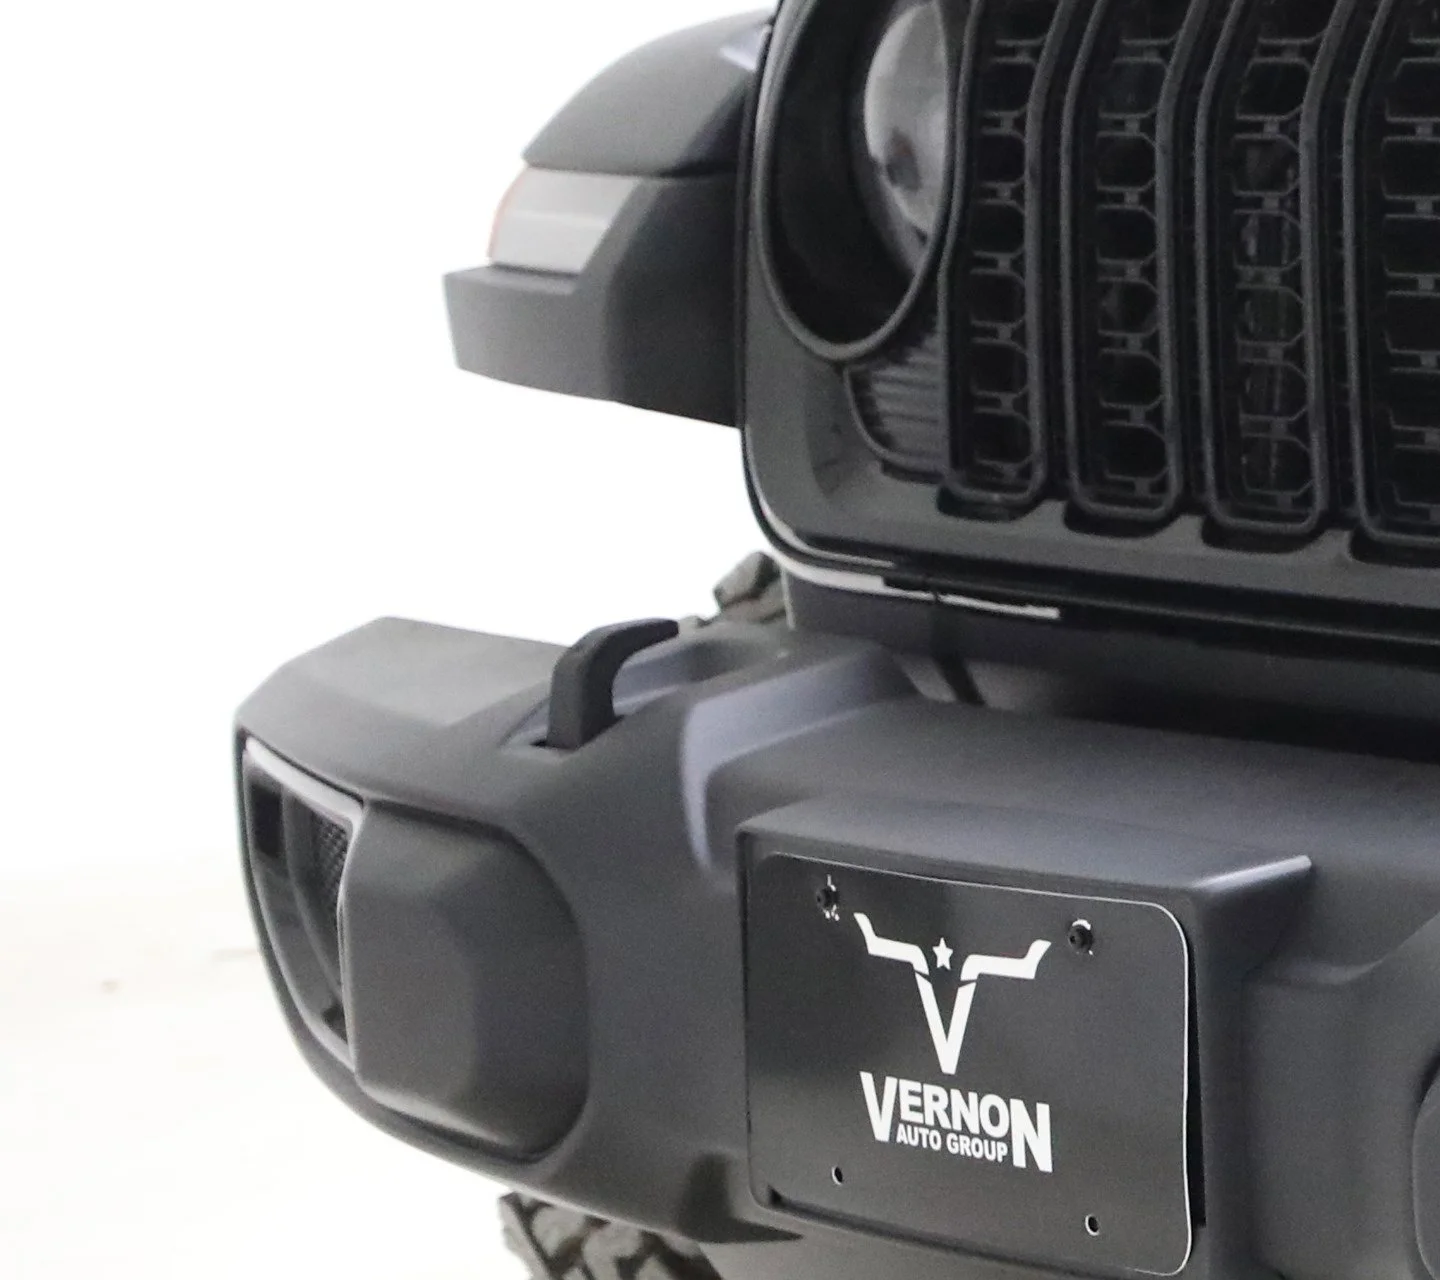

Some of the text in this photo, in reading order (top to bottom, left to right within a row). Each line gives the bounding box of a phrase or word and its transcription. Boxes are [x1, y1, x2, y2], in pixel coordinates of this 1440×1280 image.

[860, 1070, 1053, 1173] VERNON
[896, 1122, 1008, 1163] AUTO GROUP
